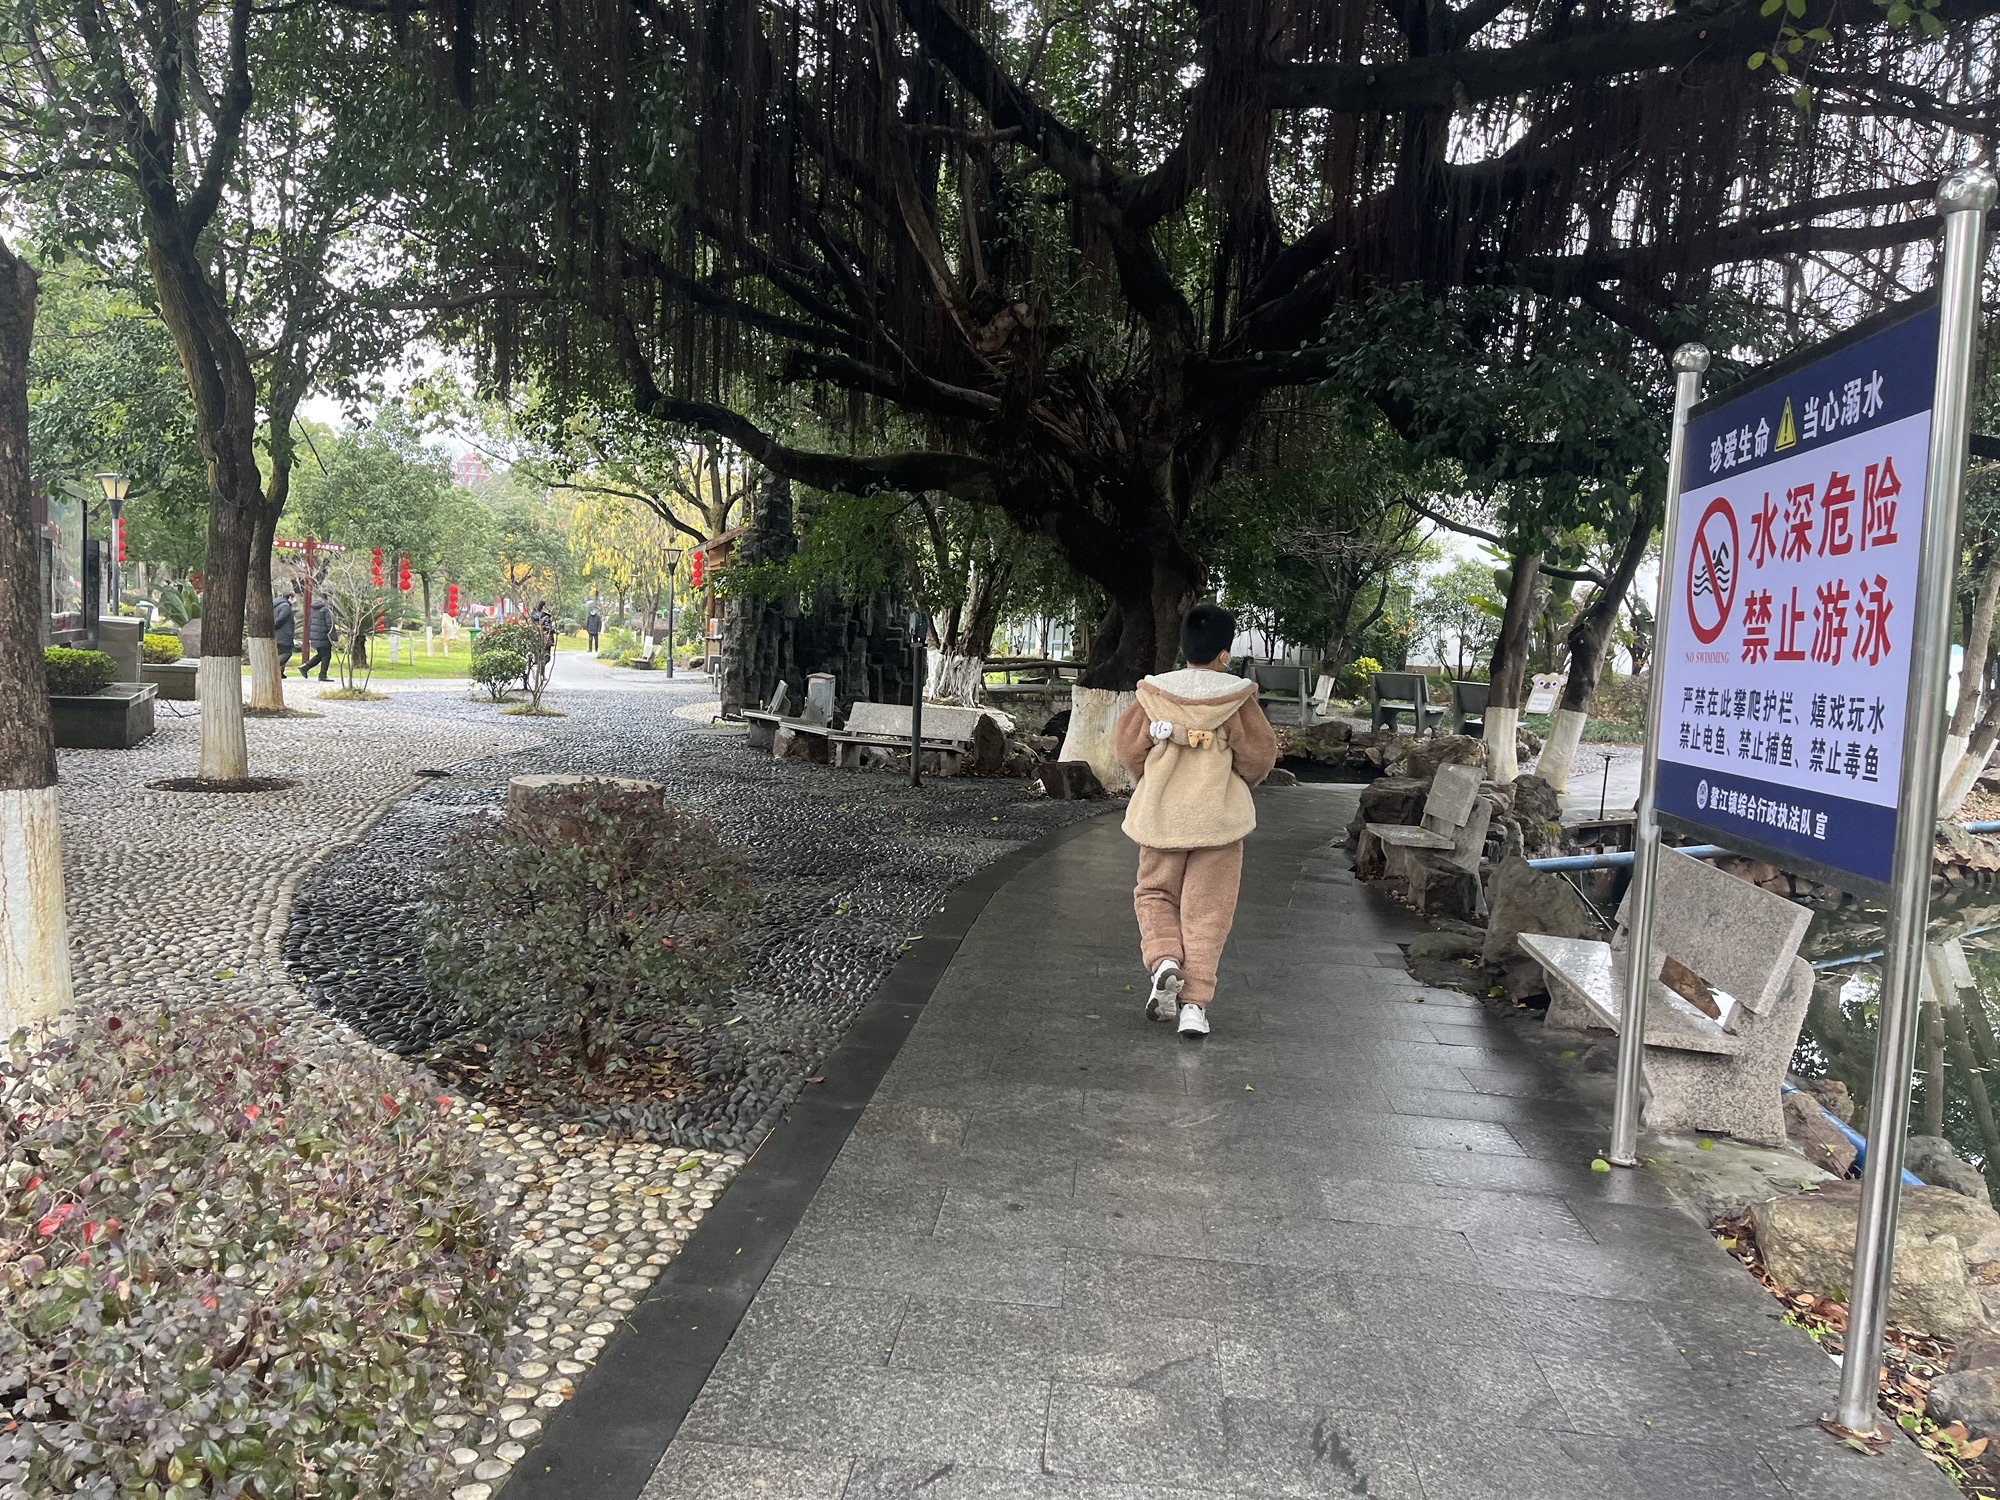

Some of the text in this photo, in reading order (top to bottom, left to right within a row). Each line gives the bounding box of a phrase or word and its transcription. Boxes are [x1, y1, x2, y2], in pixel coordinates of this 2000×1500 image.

[1709, 369, 1884, 474] 珍爱生命 当心溺水
[1747, 456, 1902, 570] 水深危险
[1685, 651, 1730, 663] NO SWIMMING
[1741, 573, 1894, 666] 禁止游泳
